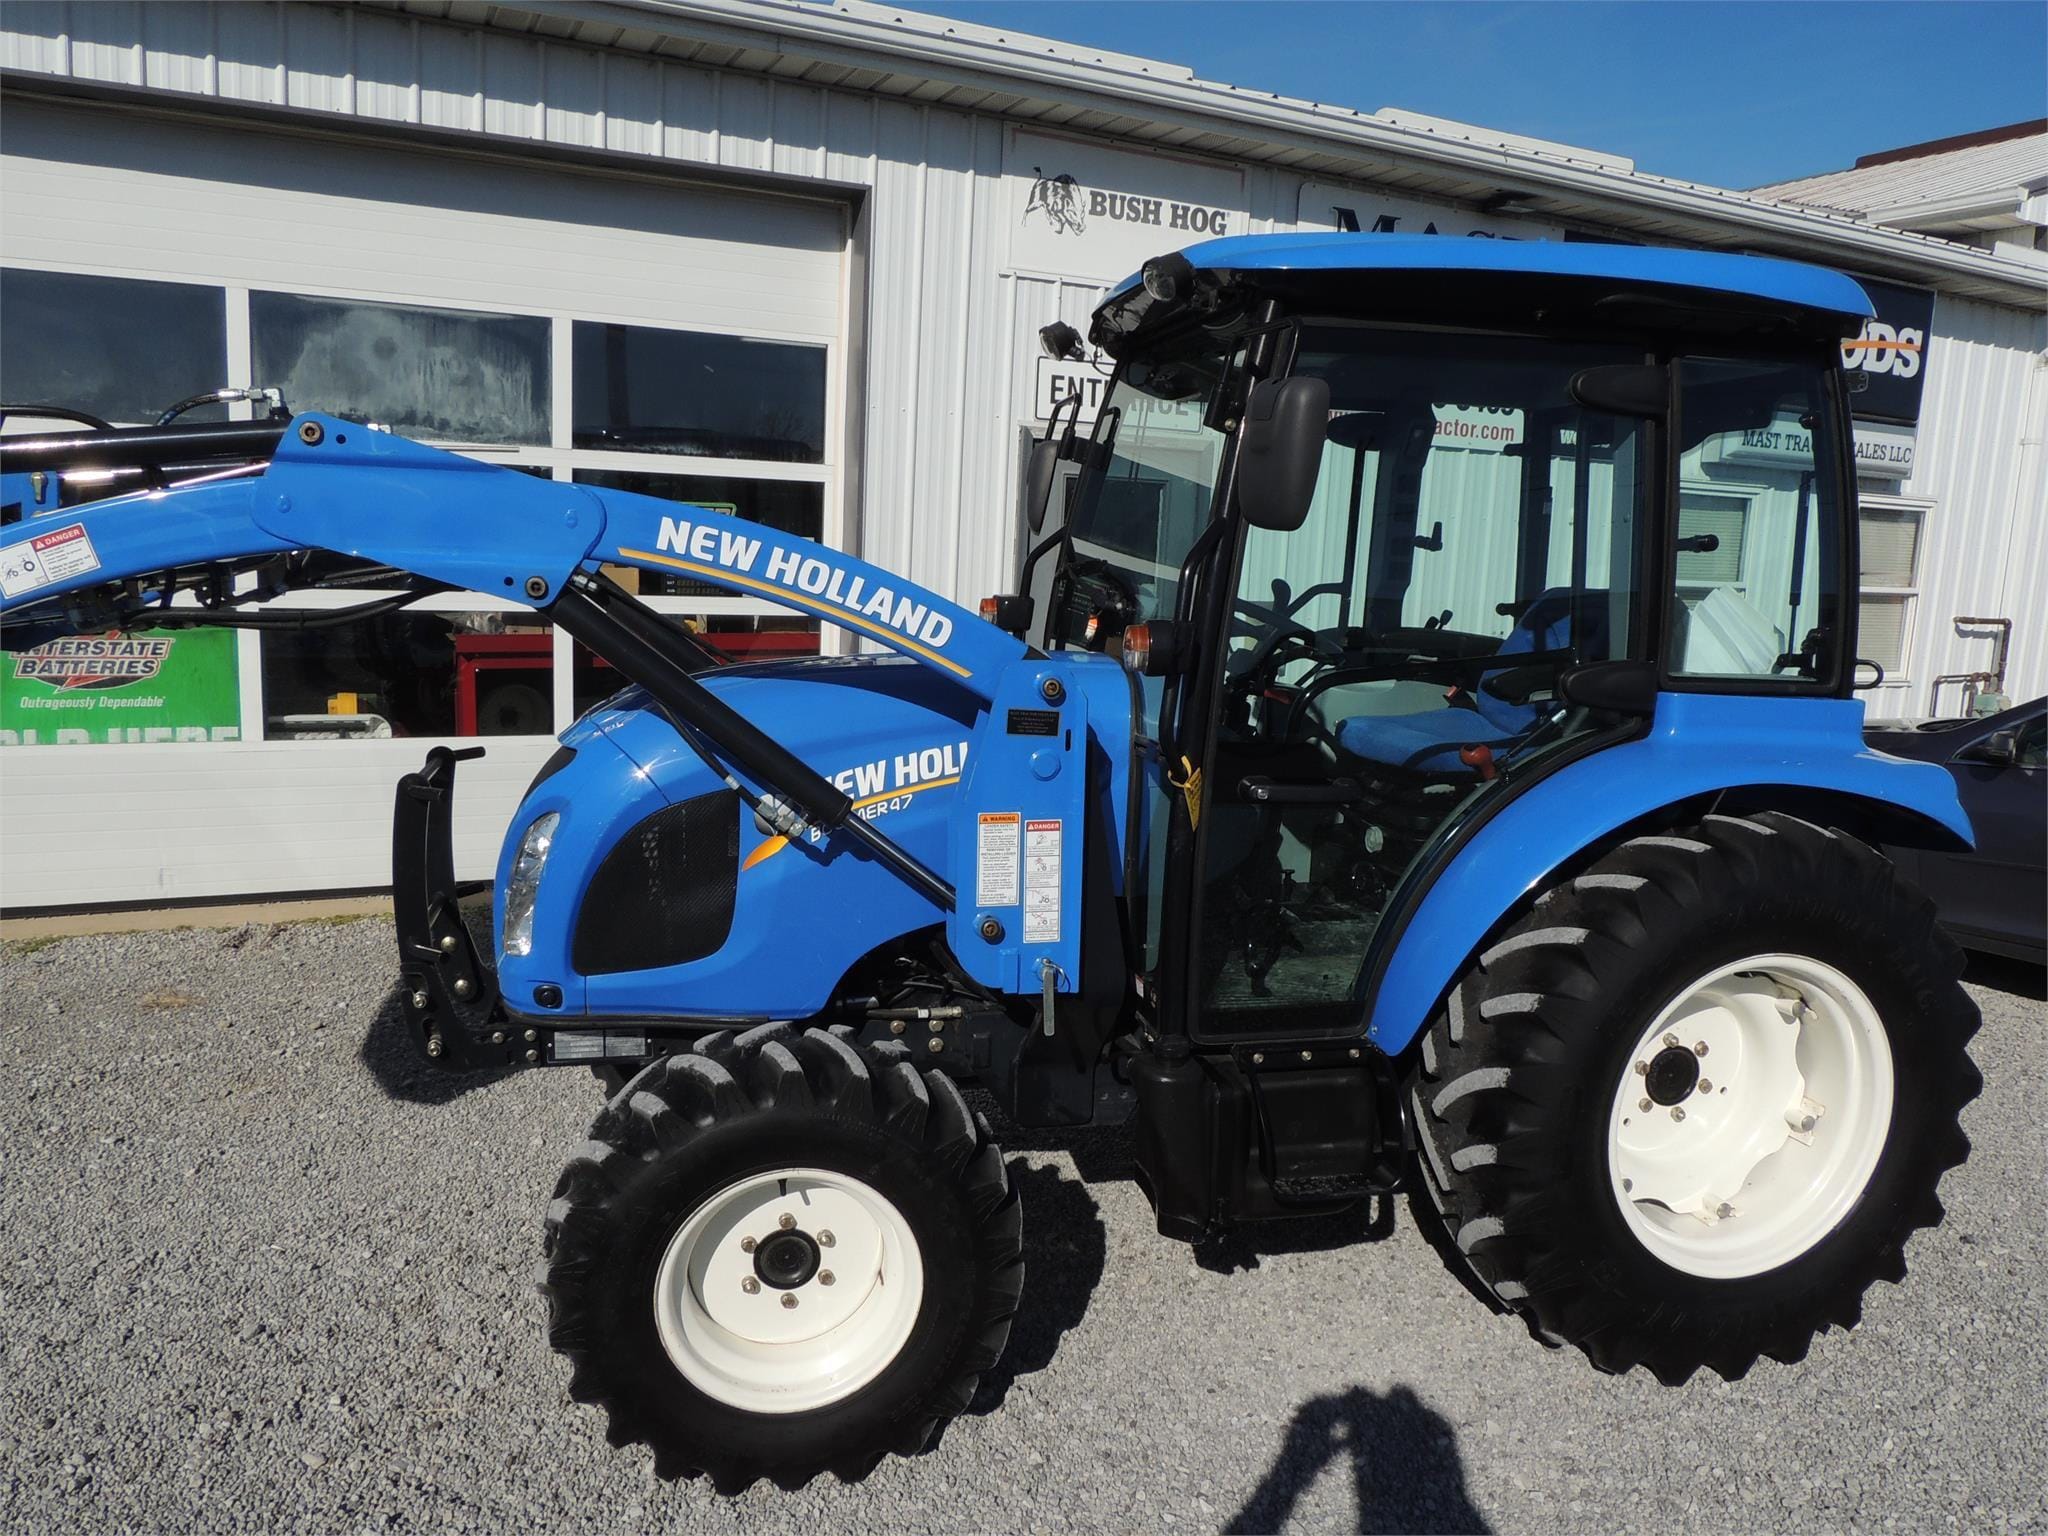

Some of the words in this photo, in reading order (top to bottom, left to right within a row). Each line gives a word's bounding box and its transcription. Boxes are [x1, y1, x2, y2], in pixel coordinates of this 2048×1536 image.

[1088, 190, 1162, 226] BUSH
[1169, 203, 1227, 236] HOG
[1742, 430, 1782, 450] MAST
[1854, 442, 1888, 461] ALES
[1890, 446, 1912, 464] LLC
[44, 529, 81, 545] DANGER
[656, 516, 762, 572] NEW
[765, 546, 953, 648] HOLLAND
[21, 659, 156, 675] BATTERIES
[20, 696, 96, 711] Outrageously
[99, 696, 164, 710] Dependable
[827, 760, 887, 801] EW
[1033, 822, 1060, 830] DANGER
